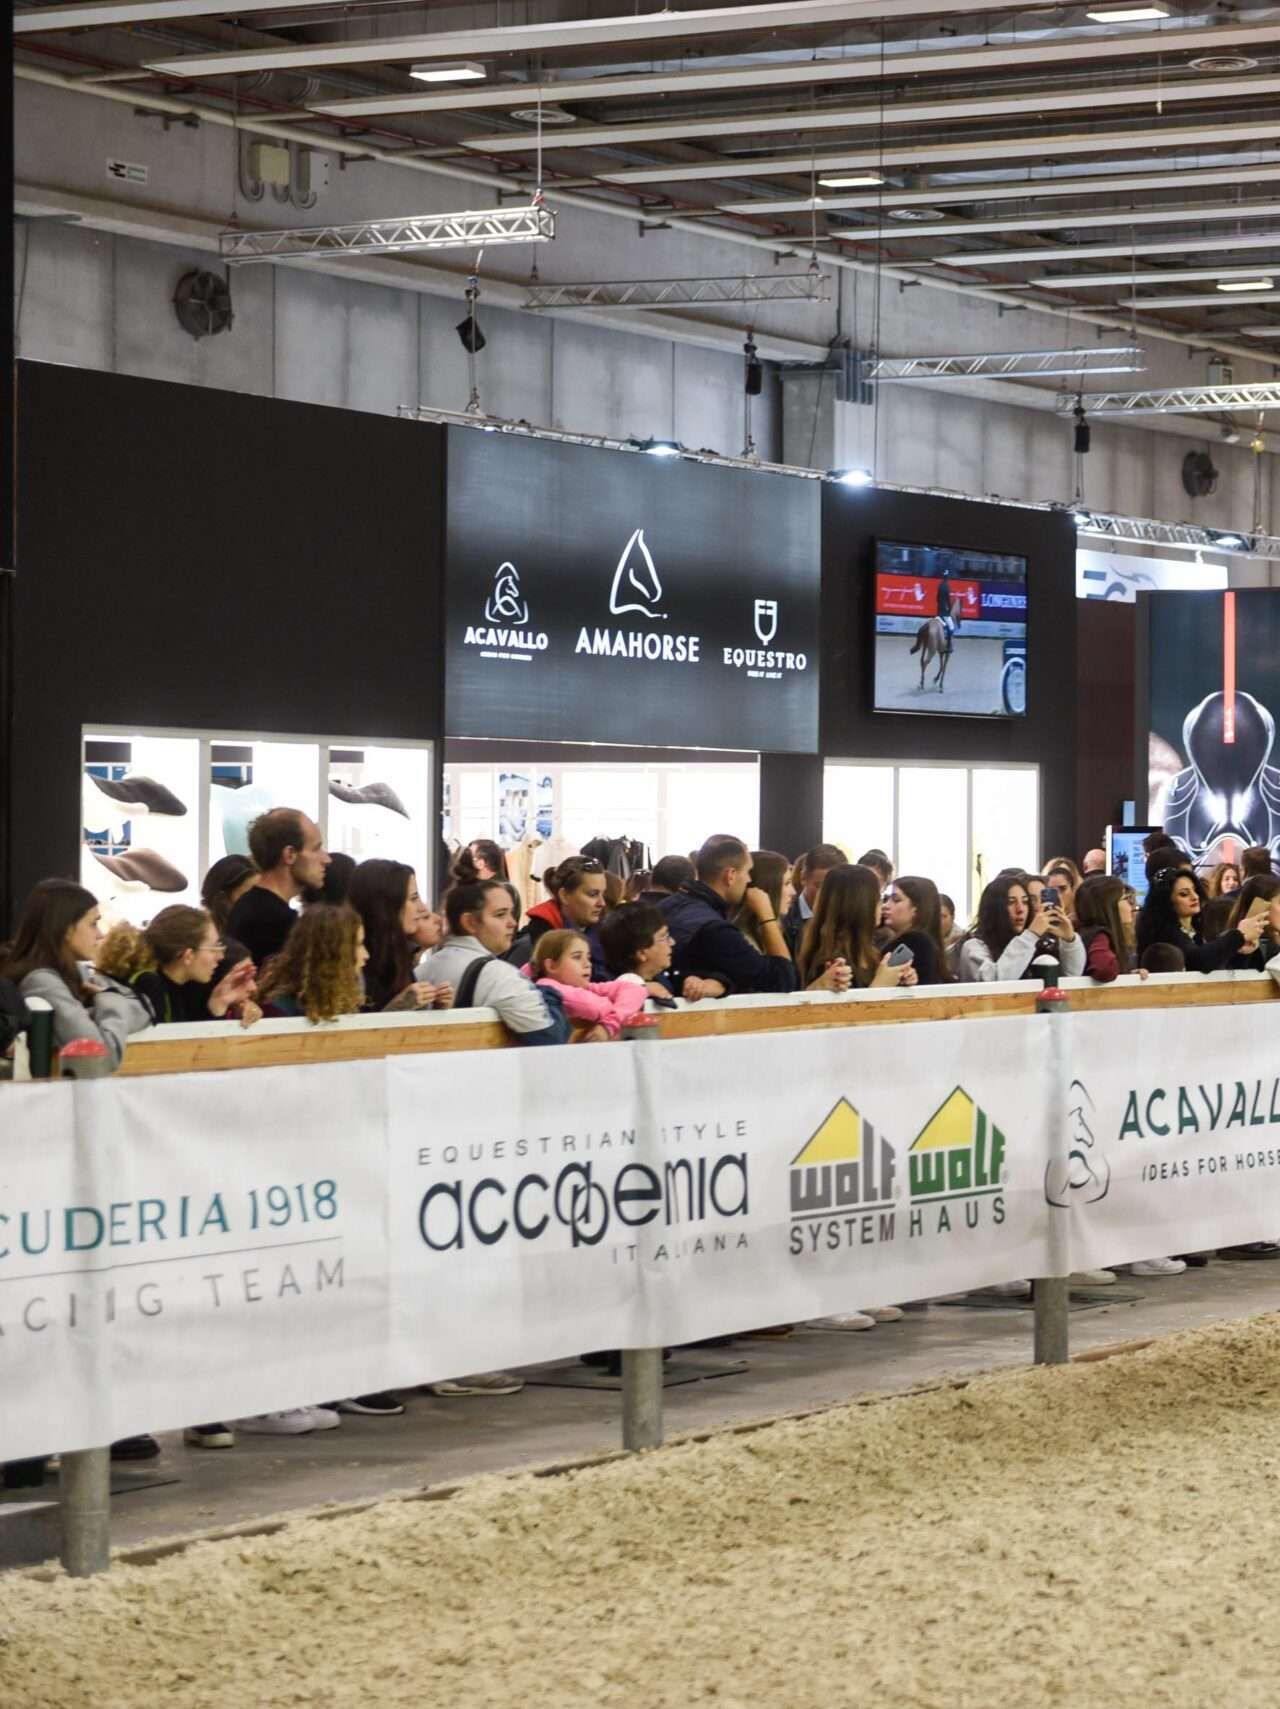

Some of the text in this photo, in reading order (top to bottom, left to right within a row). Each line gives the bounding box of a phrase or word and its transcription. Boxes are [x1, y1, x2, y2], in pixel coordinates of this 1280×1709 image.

[464, 626, 549, 651] ACAVALLO
[575, 627, 700, 663] AMAHORSE
[723, 647, 807, 671] EQUESTRO
[417, 1128, 638, 1166] EQUESTRIAN
[1142, 1159, 1190, 1183] IDEAS
[1198, 1154, 1228, 1175] FOR
[248, 1178, 339, 1231] 1918
[909, 1197, 1006, 1238] HAUS
[789, 1212, 896, 1255] SYSTEM
[202, 1256, 346, 1309] TEAM
